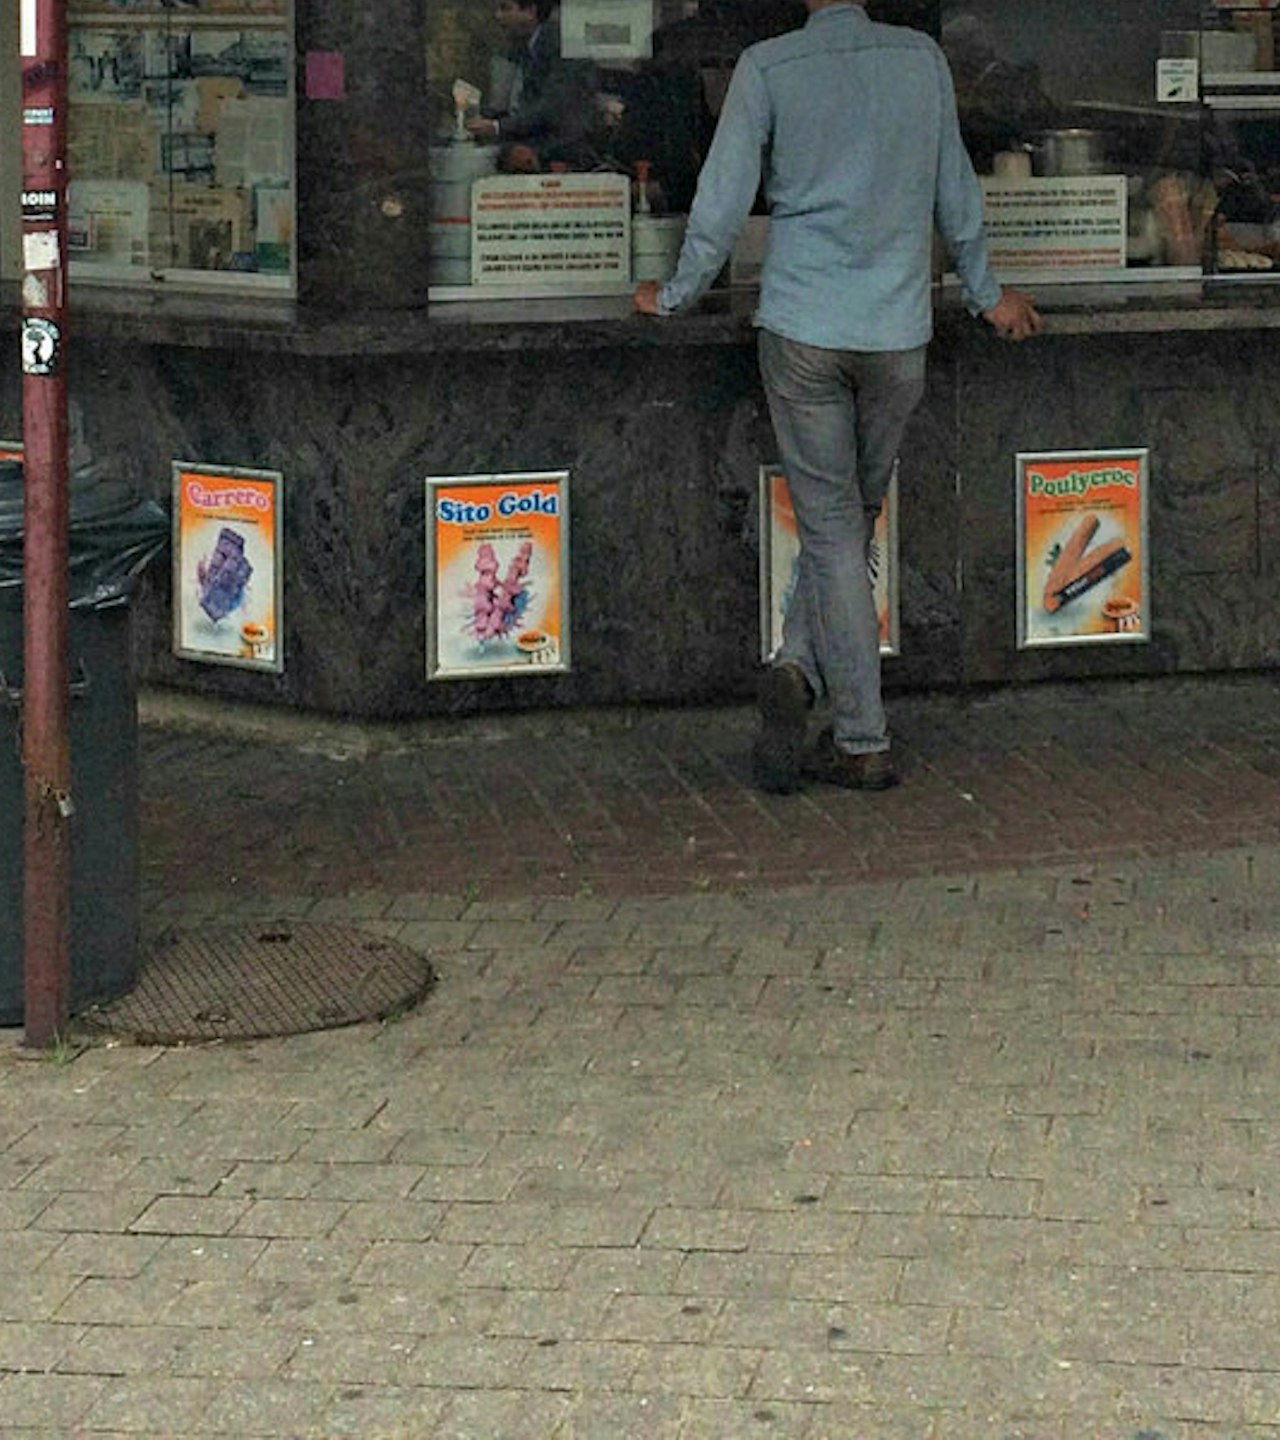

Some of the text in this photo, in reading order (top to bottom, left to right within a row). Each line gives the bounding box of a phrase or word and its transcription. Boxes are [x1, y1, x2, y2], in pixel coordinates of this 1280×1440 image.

[188, 481, 269, 512] Carrero
[439, 492, 559, 524] Sito Gold
